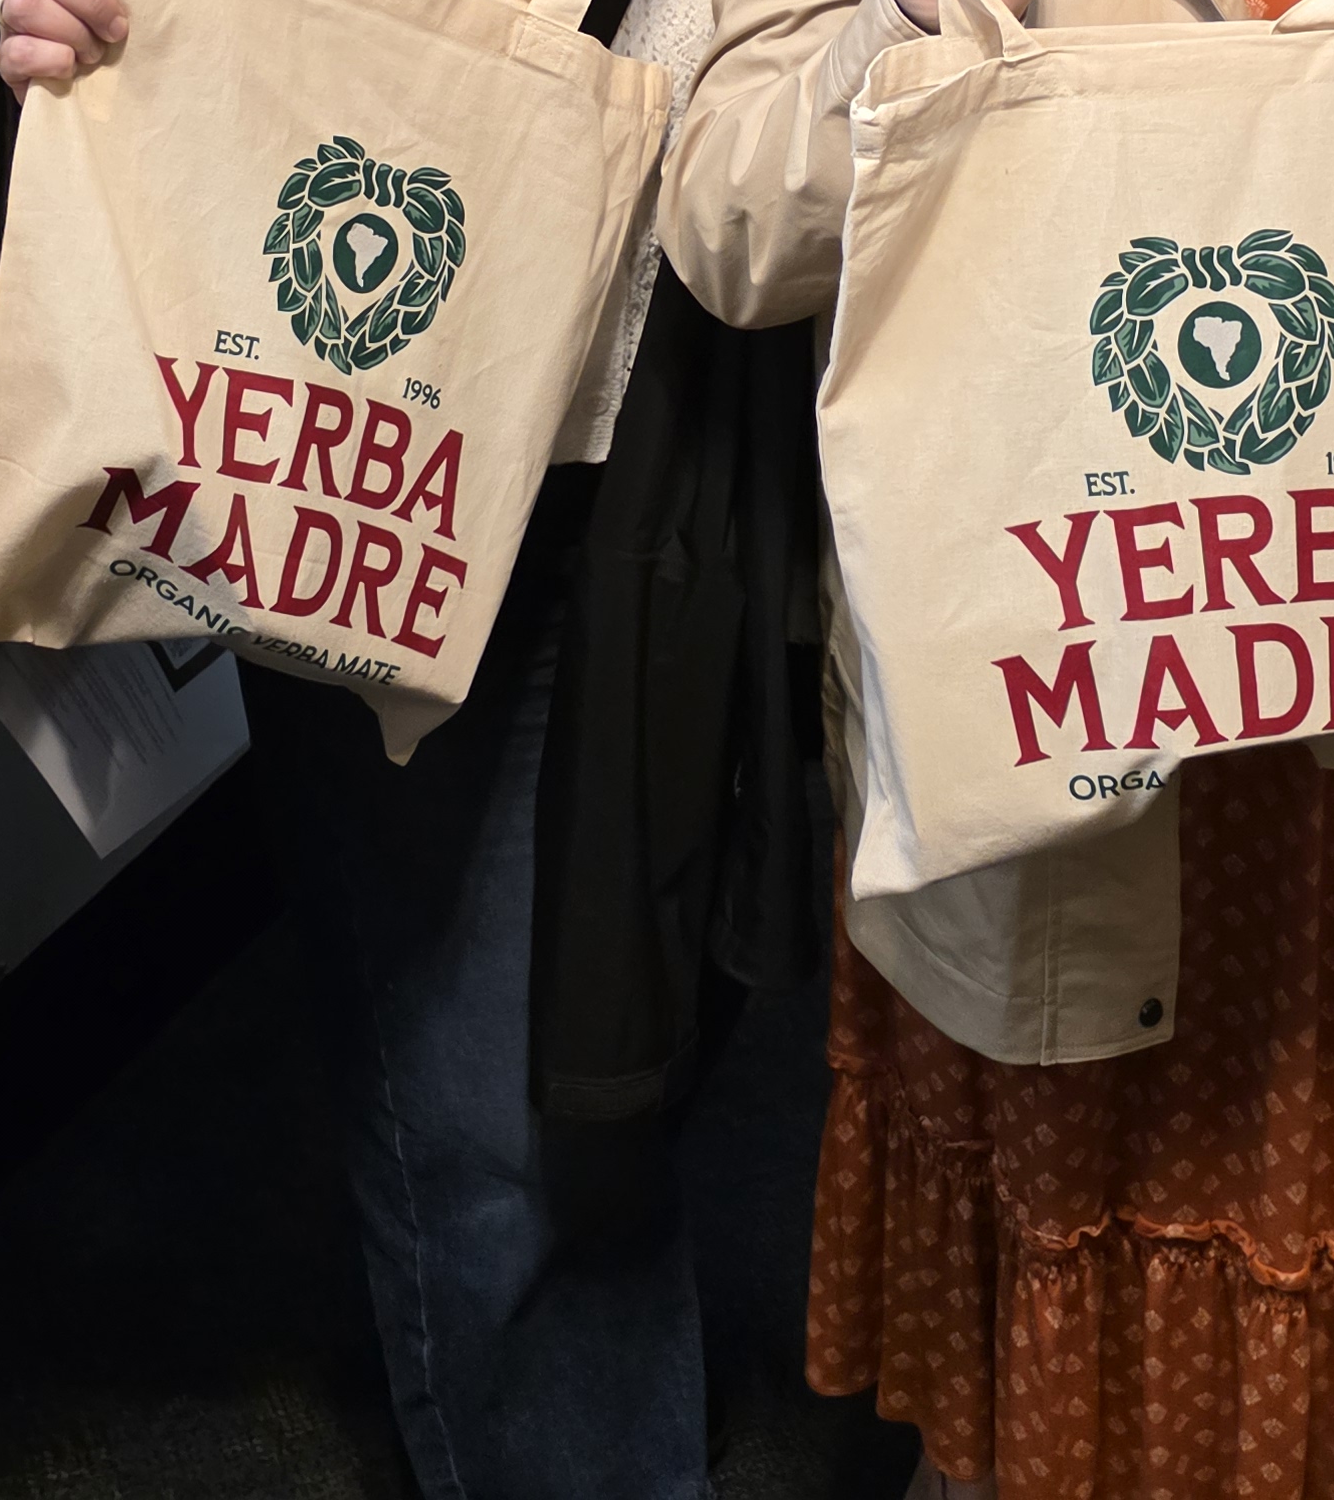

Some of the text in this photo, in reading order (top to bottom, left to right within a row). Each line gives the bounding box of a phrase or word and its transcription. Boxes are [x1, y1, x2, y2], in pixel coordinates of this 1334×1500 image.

[214, 330, 260, 361] EST.
[402, 377, 442, 409] 1996
[154, 352, 464, 541] YERBA
[1084, 472, 1136, 497] EST.
[76, 467, 467, 658] MADRE
[334, 652, 401, 686] MATE
